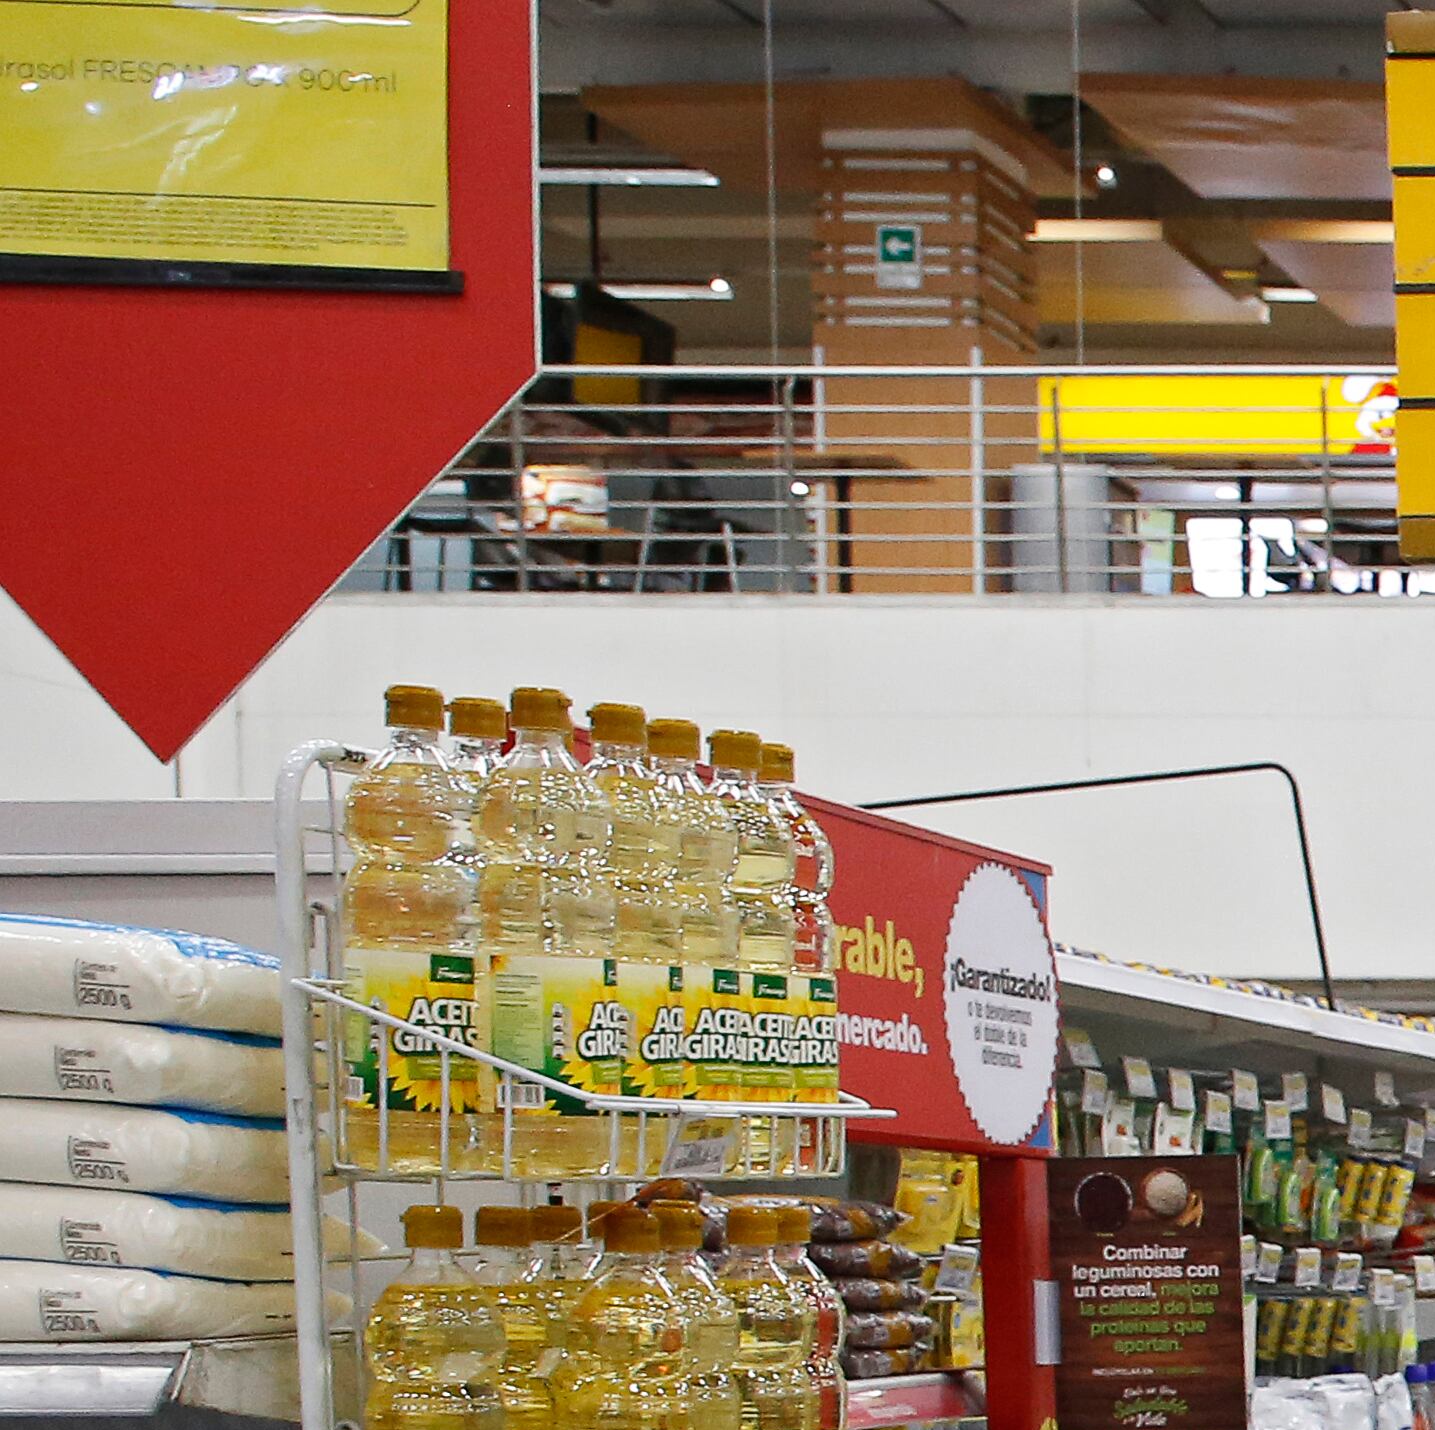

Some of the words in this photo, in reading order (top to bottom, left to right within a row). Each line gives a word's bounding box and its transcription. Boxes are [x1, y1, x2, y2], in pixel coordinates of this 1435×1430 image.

[951, 957, 1051, 1002] ¡Garantizado!
[1103, 1244, 1188, 1261] Combinar
[1072, 1264, 1184, 1283] leguminosas
[1186, 1264, 1221, 1278] con
[1074, 1285, 1097, 1298] un
[1160, 1281, 1220, 1299] mejora
[1173, 1320, 1207, 1337] que
